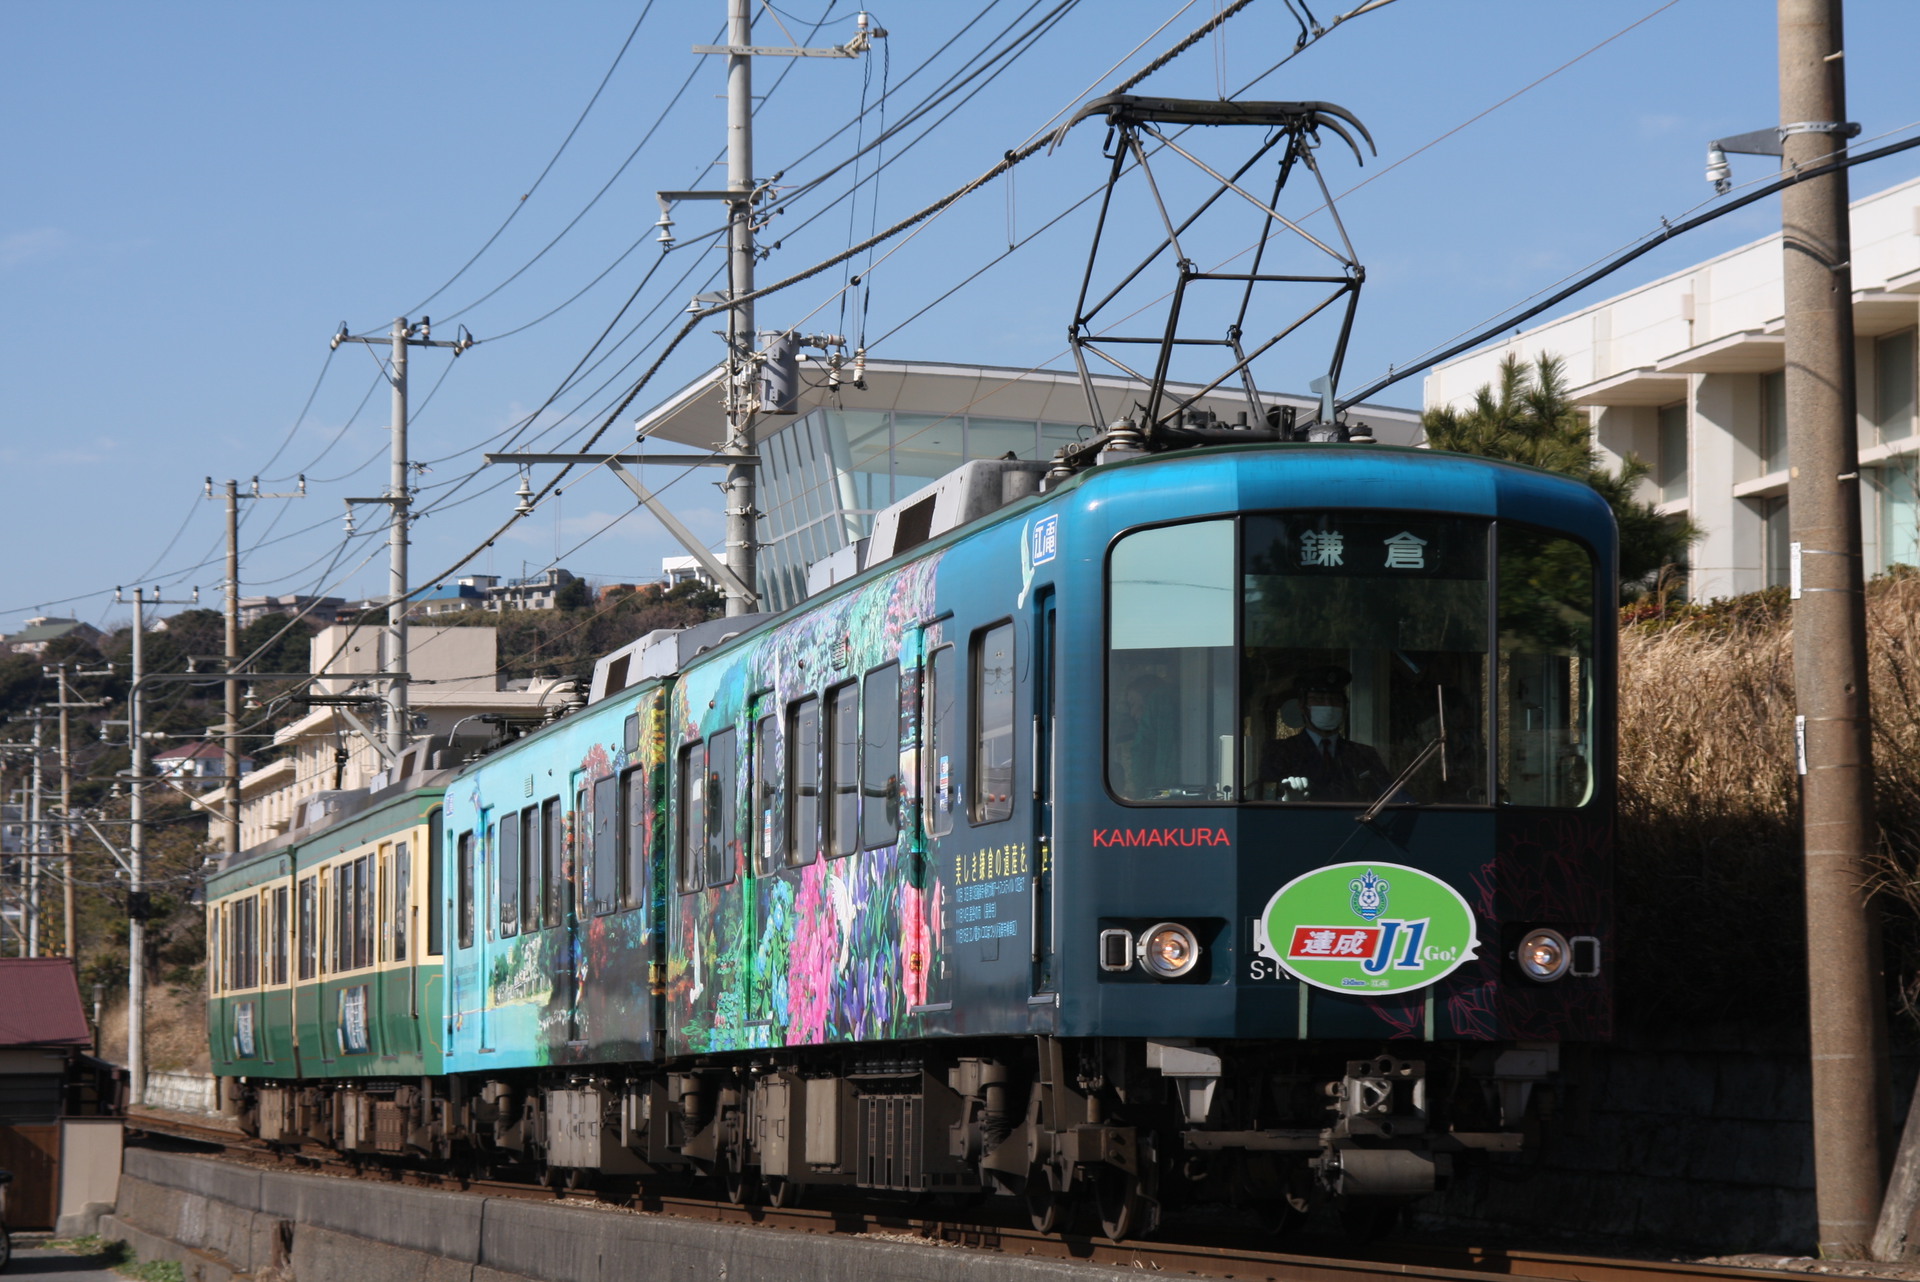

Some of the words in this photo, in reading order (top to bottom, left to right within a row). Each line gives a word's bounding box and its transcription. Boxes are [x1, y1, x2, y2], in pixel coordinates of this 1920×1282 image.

[1300, 529, 1428, 569] 鎌倉
[1093, 828, 1230, 848] KAMAKURA
[1300, 930, 1368, 955] 達成
[1362, 919, 1427, 974] J1
[1423, 945, 1457, 962] Go!
